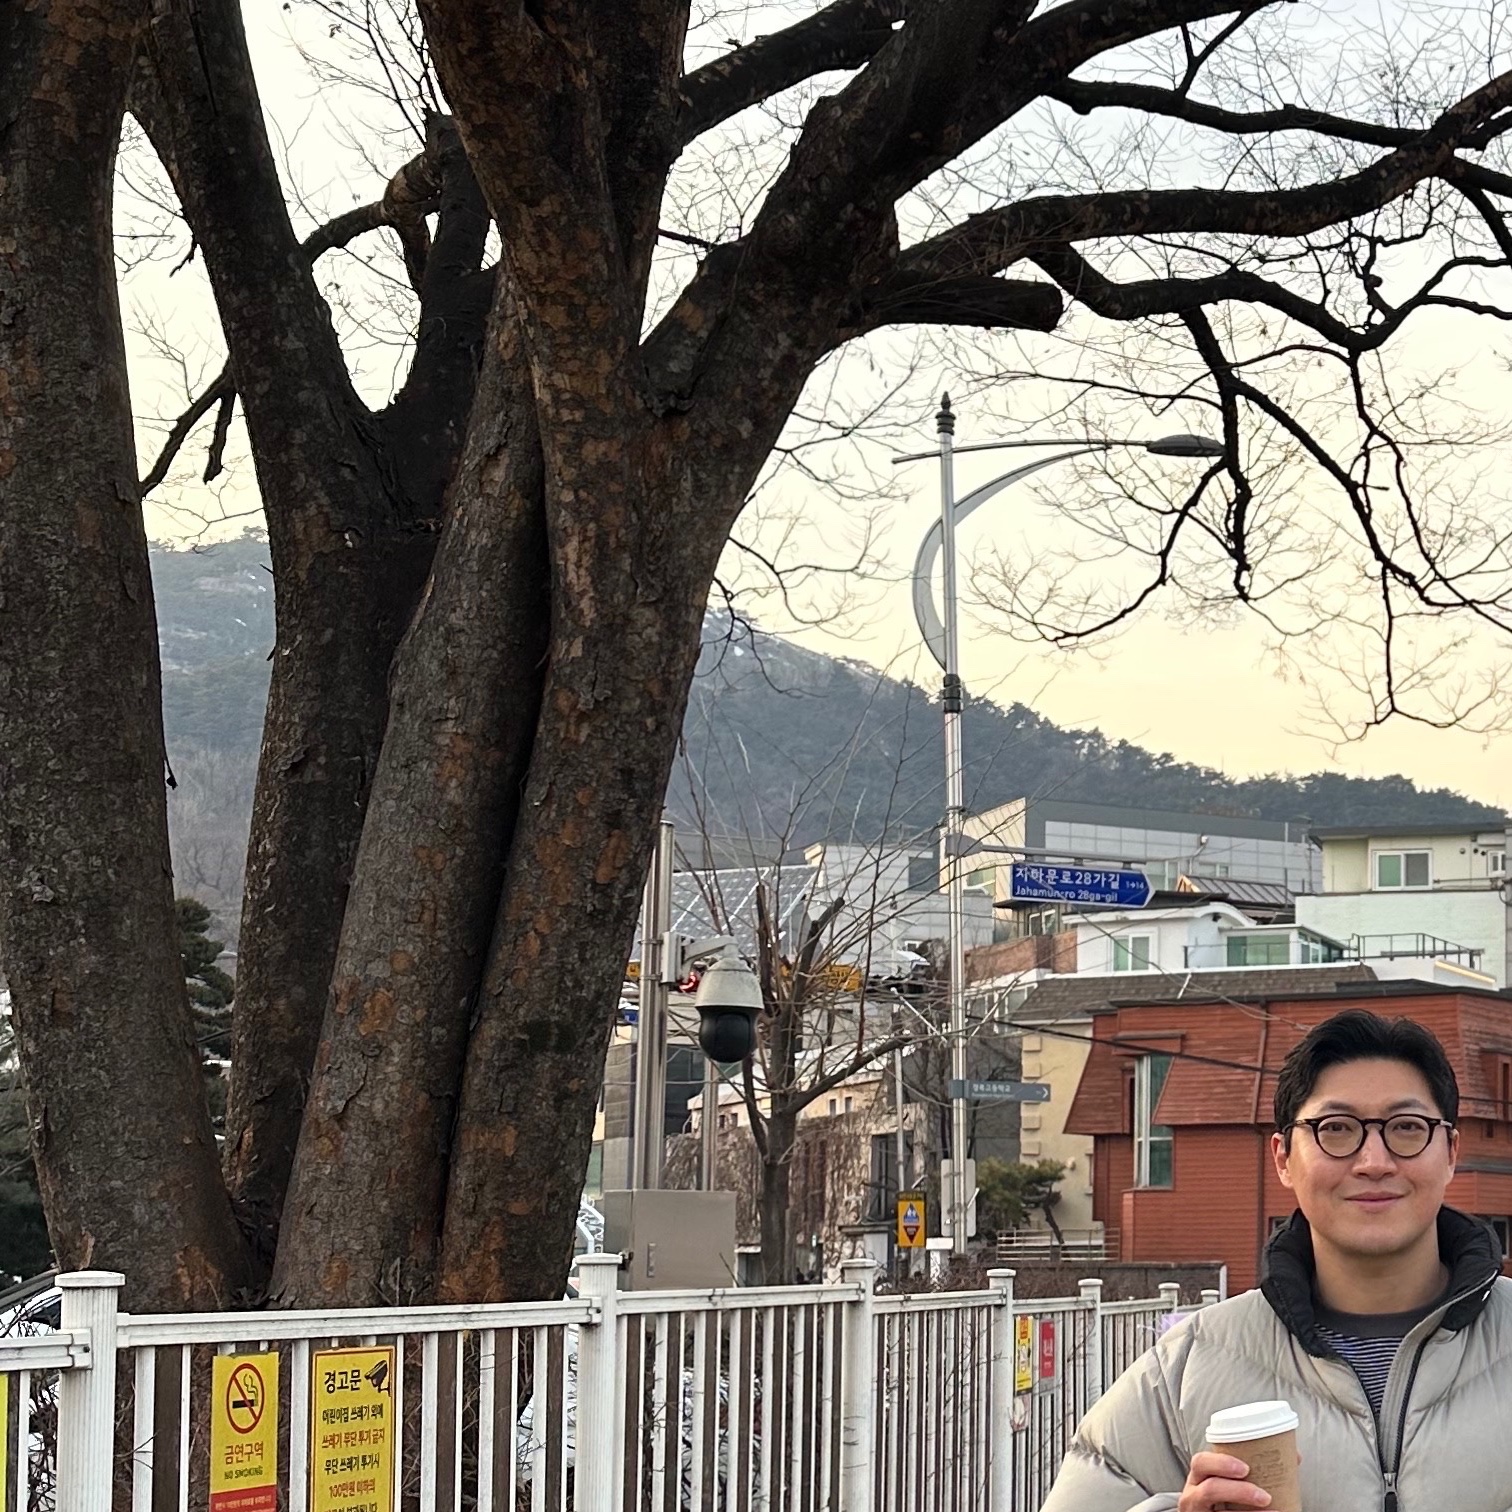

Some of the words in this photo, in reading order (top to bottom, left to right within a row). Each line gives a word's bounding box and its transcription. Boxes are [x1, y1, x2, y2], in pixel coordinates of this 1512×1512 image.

[1015, 867, 1120, 889] 자하문로28가길
[1015, 885, 1076, 899] Jahamun-ro
[1077, 889, 1118, 903] 28ga-gil
[324, 1369, 361, 1394] 경고문
[322, 1406, 349, 1425] 어린이집
[350, 1404, 369, 1421] 쓰레기
[321, 1432, 342, 1449] 쓰레기
[343, 1430, 357, 1447] 무단
[358, 1428, 371, 1446] 투기
[372, 1427, 385, 1444] 금지
[224, 1441, 263, 1465] 금연구역
[224, 1470, 233, 1480] NO
[234, 1465, 263, 1479] SMOKING
[324, 1457, 338, 1475] 무단
[340, 1454, 359, 1472] 쓰레기
[329, 1480, 356, 1498] 100만원
